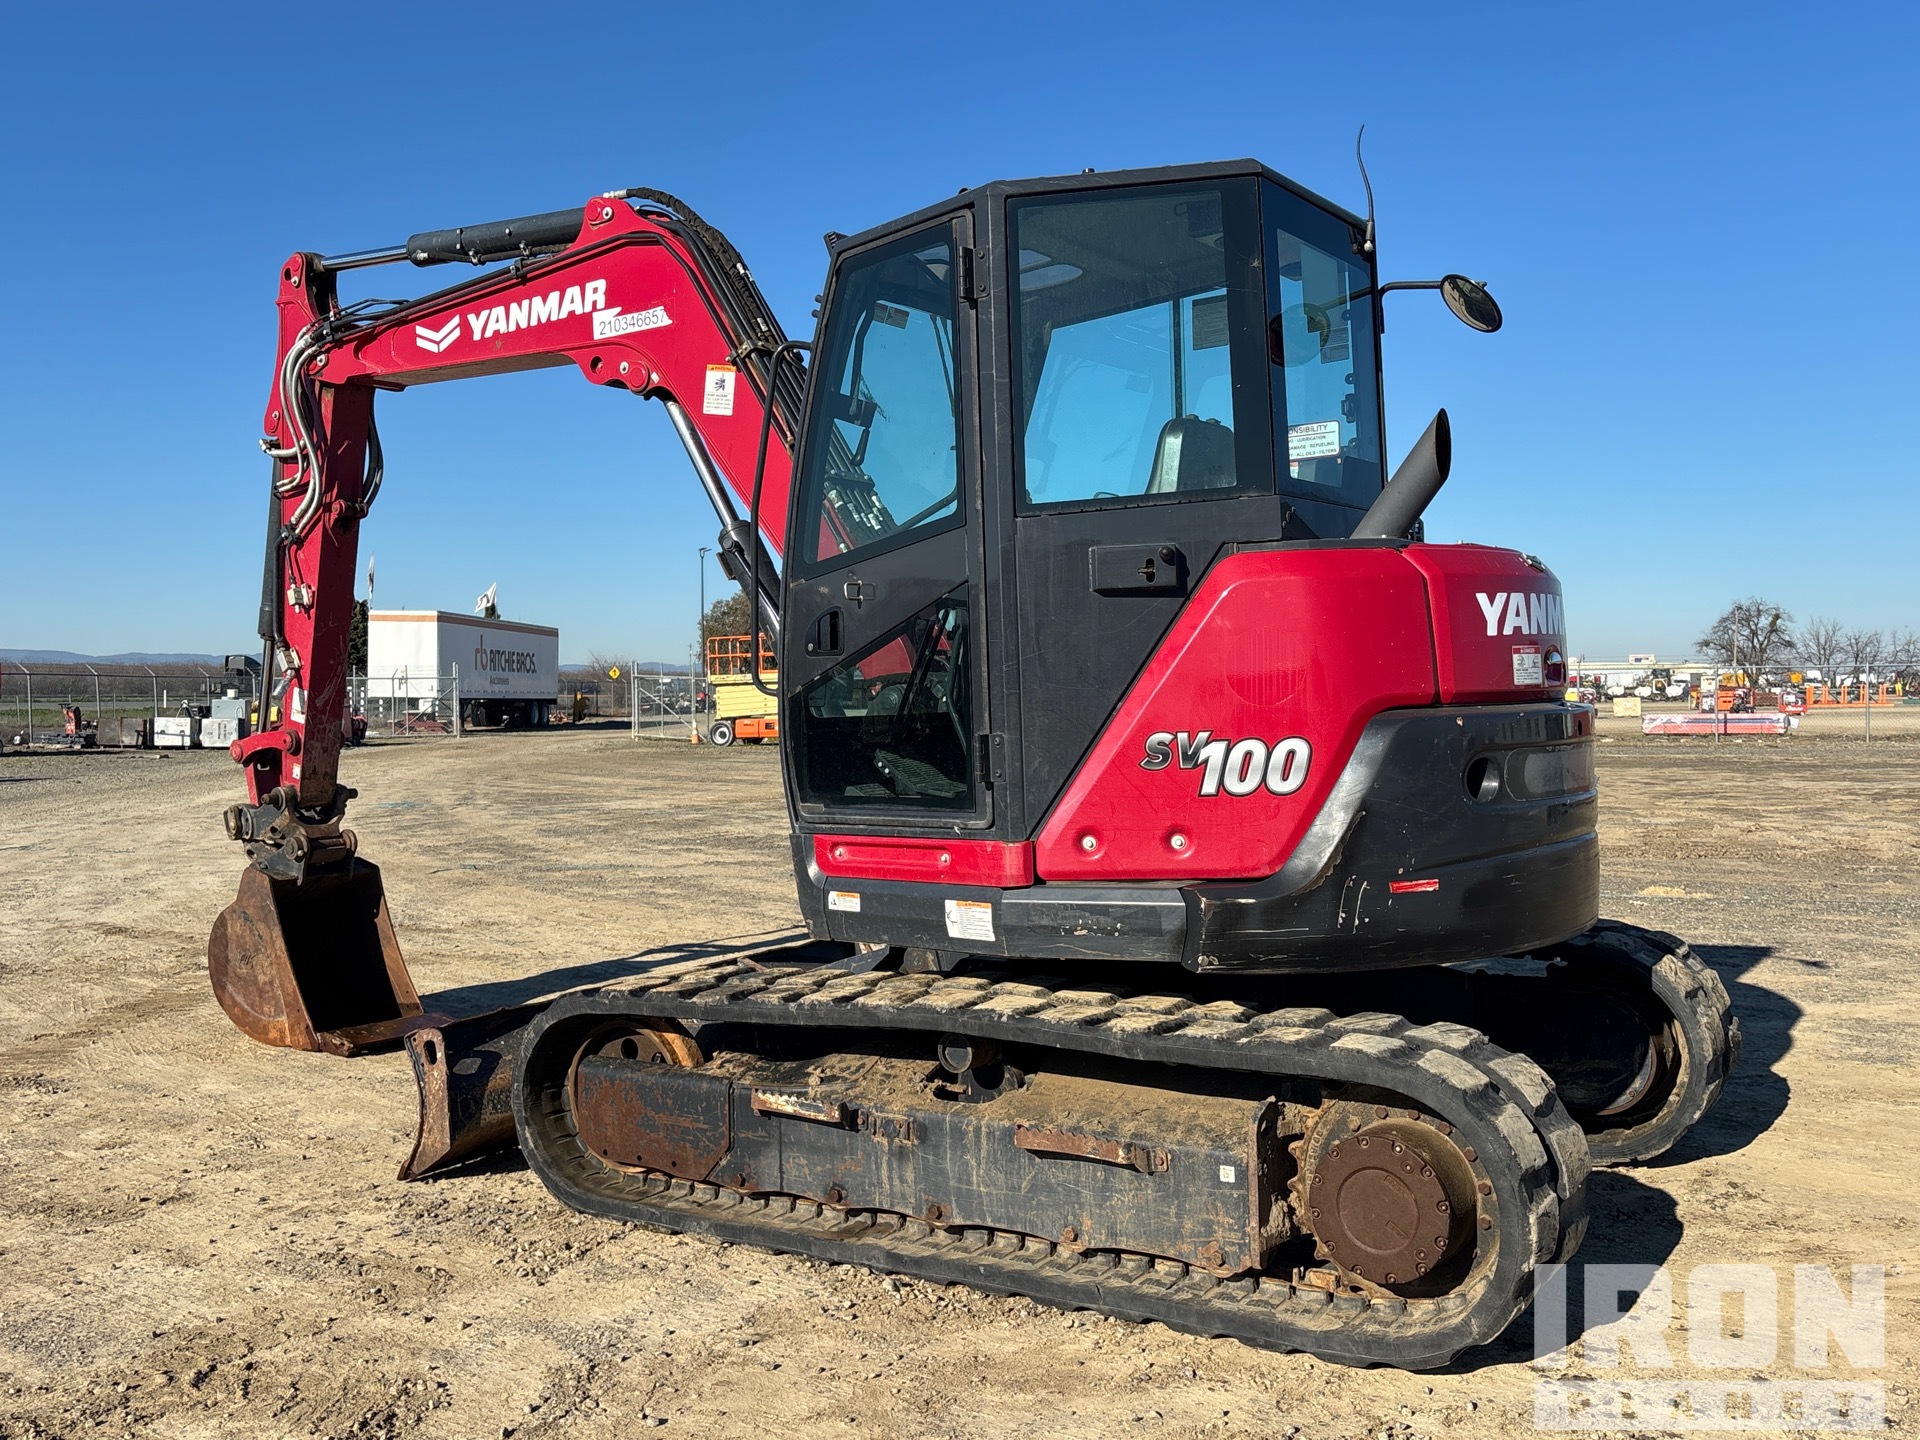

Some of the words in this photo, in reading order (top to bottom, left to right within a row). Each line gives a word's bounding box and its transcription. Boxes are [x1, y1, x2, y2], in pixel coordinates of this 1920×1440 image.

[467, 279, 606, 341] YANMAR
[599, 309, 665, 336] 210346657
[1475, 592, 1564, 637] YANM
[489, 649, 515, 673] RITCHIE
[516, 651, 537, 674] BROS.
